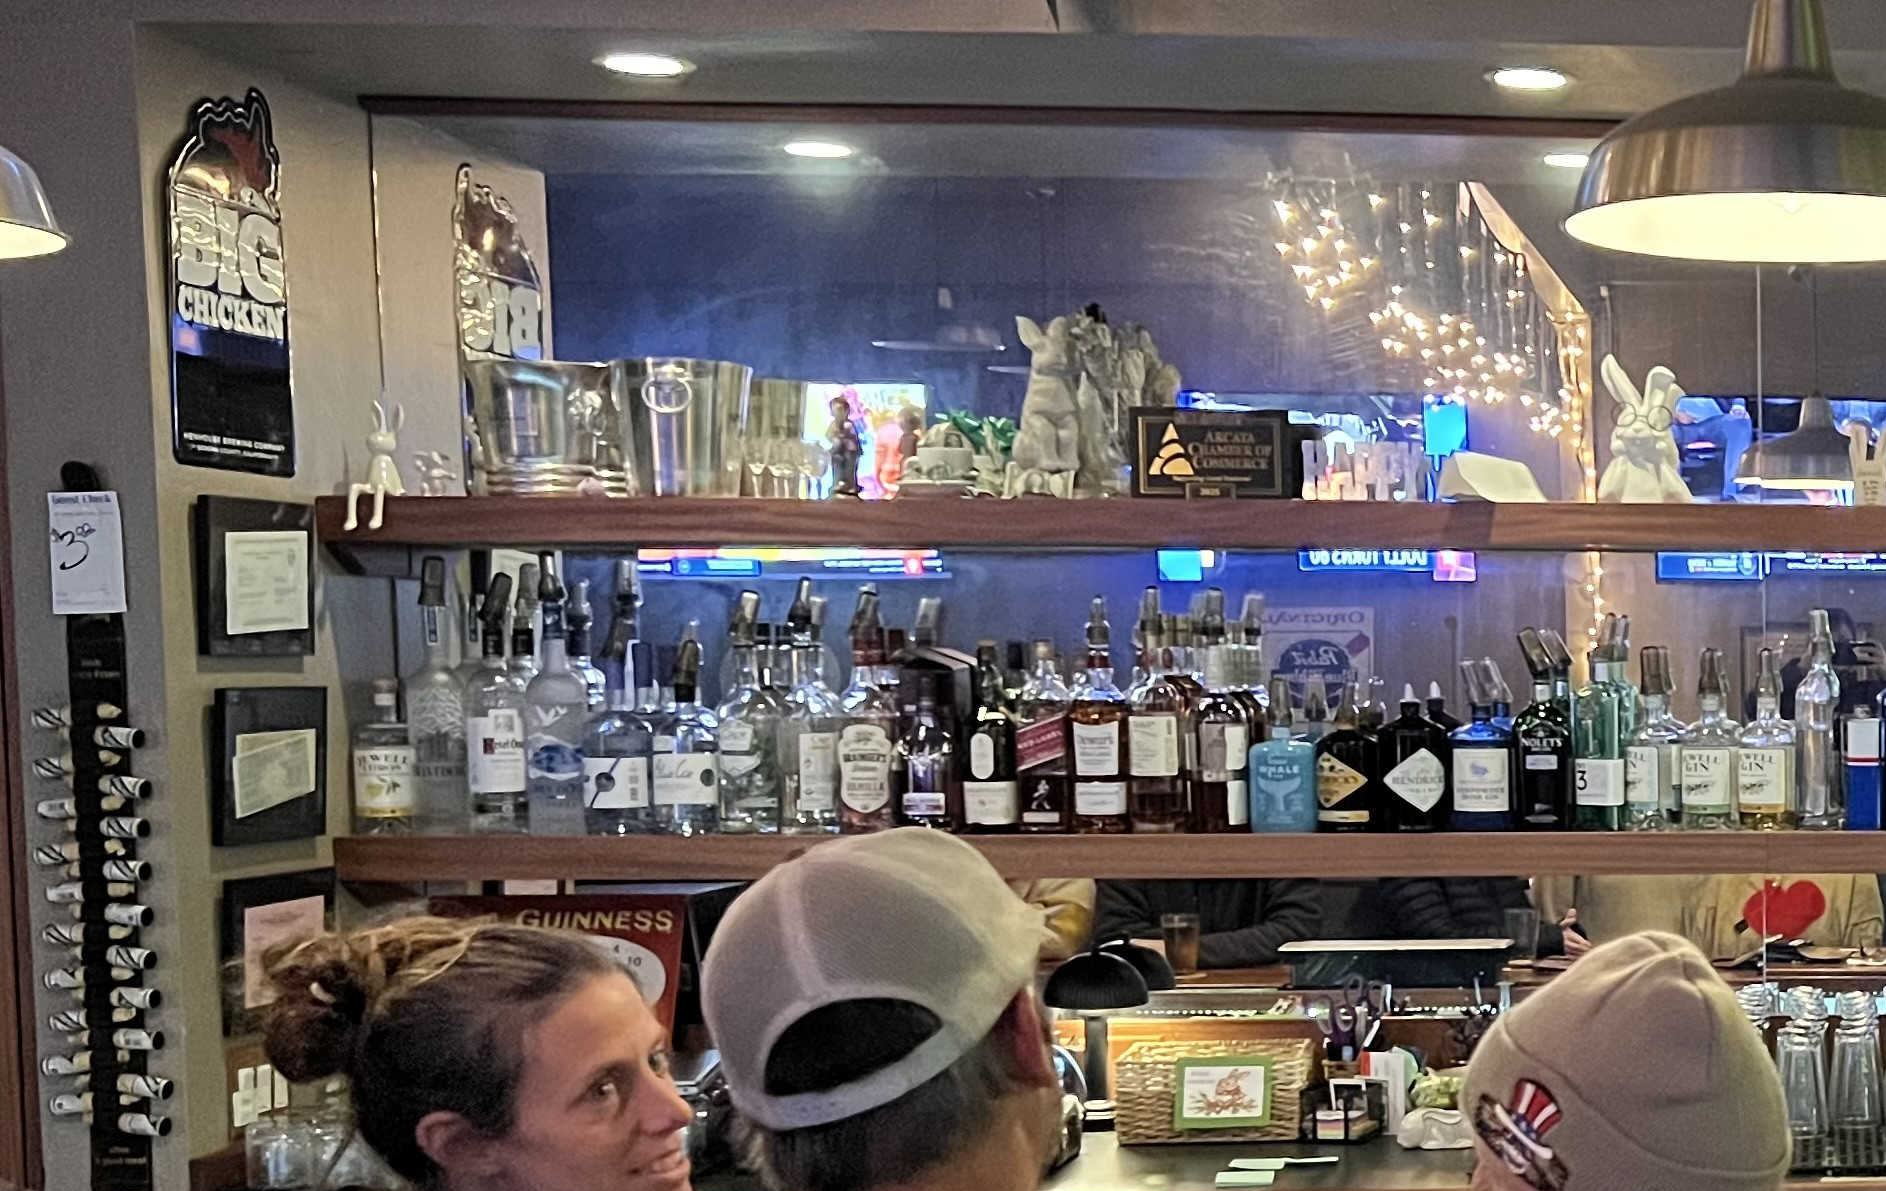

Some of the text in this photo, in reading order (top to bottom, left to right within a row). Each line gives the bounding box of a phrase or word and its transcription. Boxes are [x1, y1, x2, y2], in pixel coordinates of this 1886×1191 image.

[177, 190, 285, 304] BIG
[177, 285, 285, 340] CHICKEN
[1577, 770, 1588, 791] 3
[515, 908, 674, 934] GUINNESS
